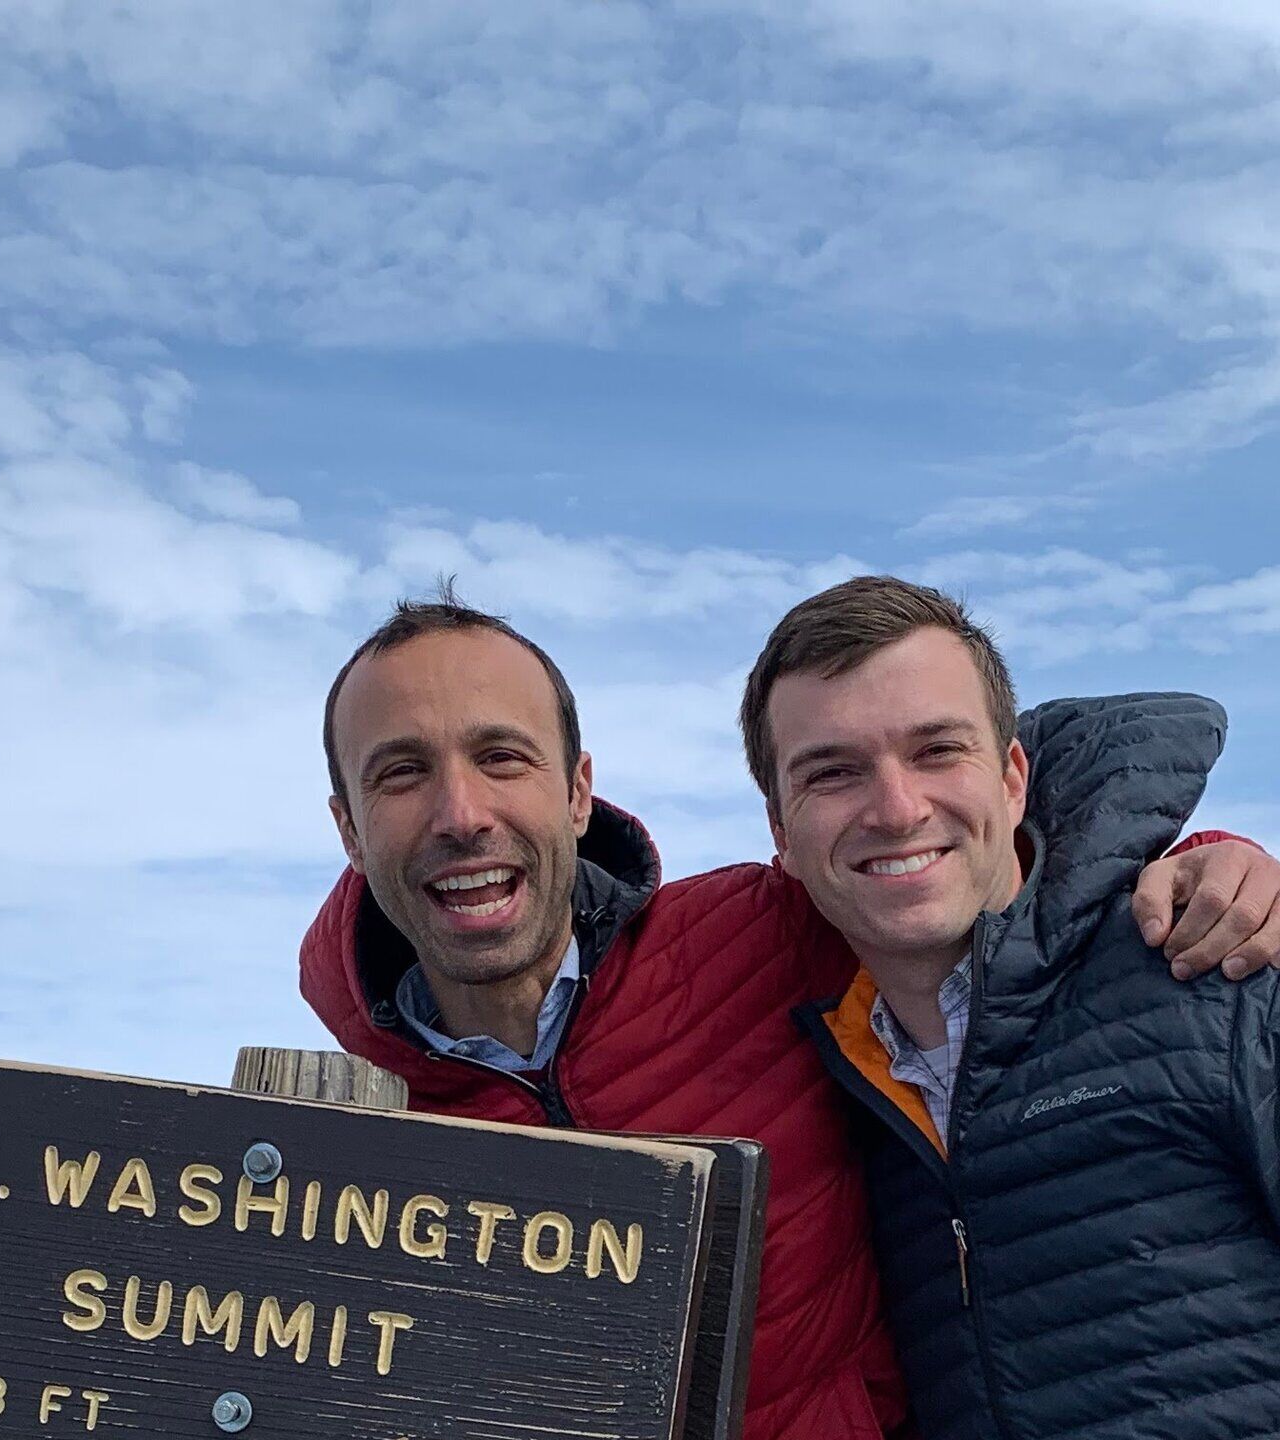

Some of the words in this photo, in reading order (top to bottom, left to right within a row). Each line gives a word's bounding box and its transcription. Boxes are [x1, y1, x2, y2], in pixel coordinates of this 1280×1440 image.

[1021, 1096, 1066, 1123] Eddie
[1067, 1085, 1122, 1105] Bauer
[43, 1143, 644, 1285] WASHINGTON
[61, 1268, 415, 1376] SUMMIT
[38, 1384, 110, 1431] FT
